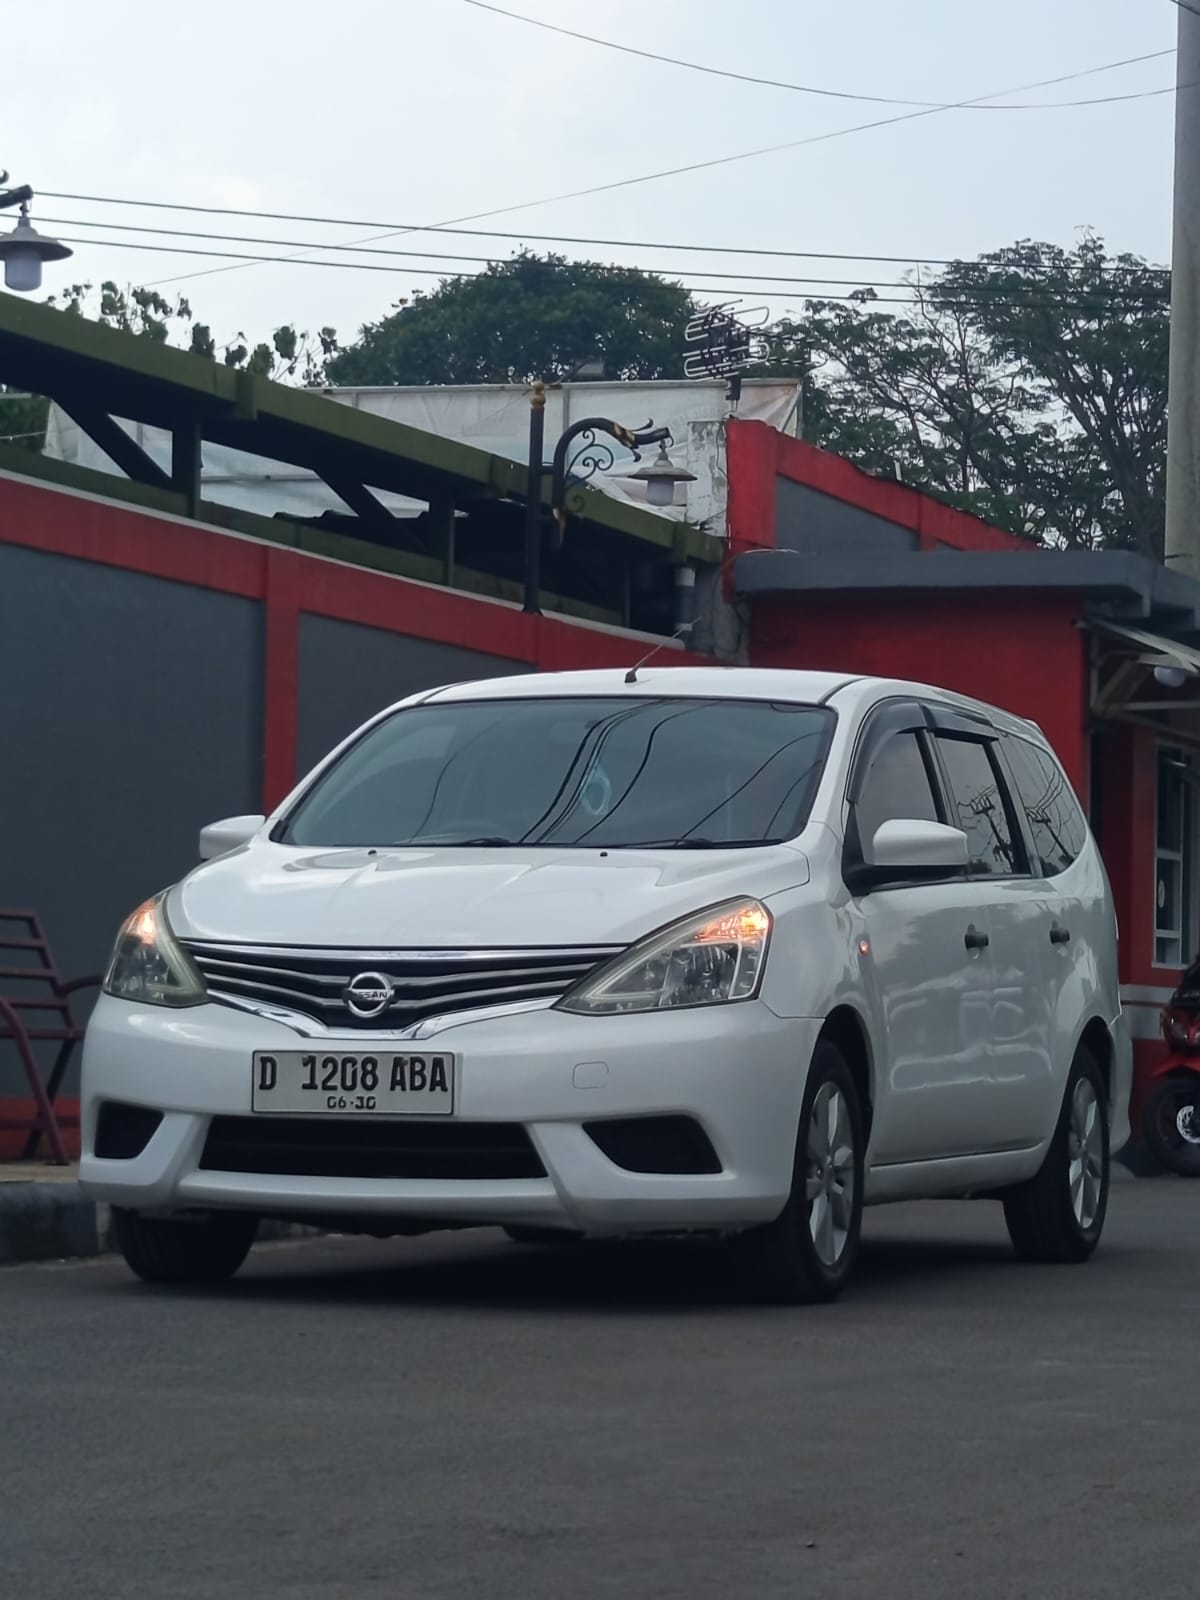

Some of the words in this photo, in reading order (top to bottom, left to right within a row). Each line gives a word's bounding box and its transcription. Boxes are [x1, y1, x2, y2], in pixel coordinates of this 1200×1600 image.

[259, 1056, 277, 1090] D
[302, 1055, 379, 1091] 1208
[390, 1057, 448, 1092] ABA
